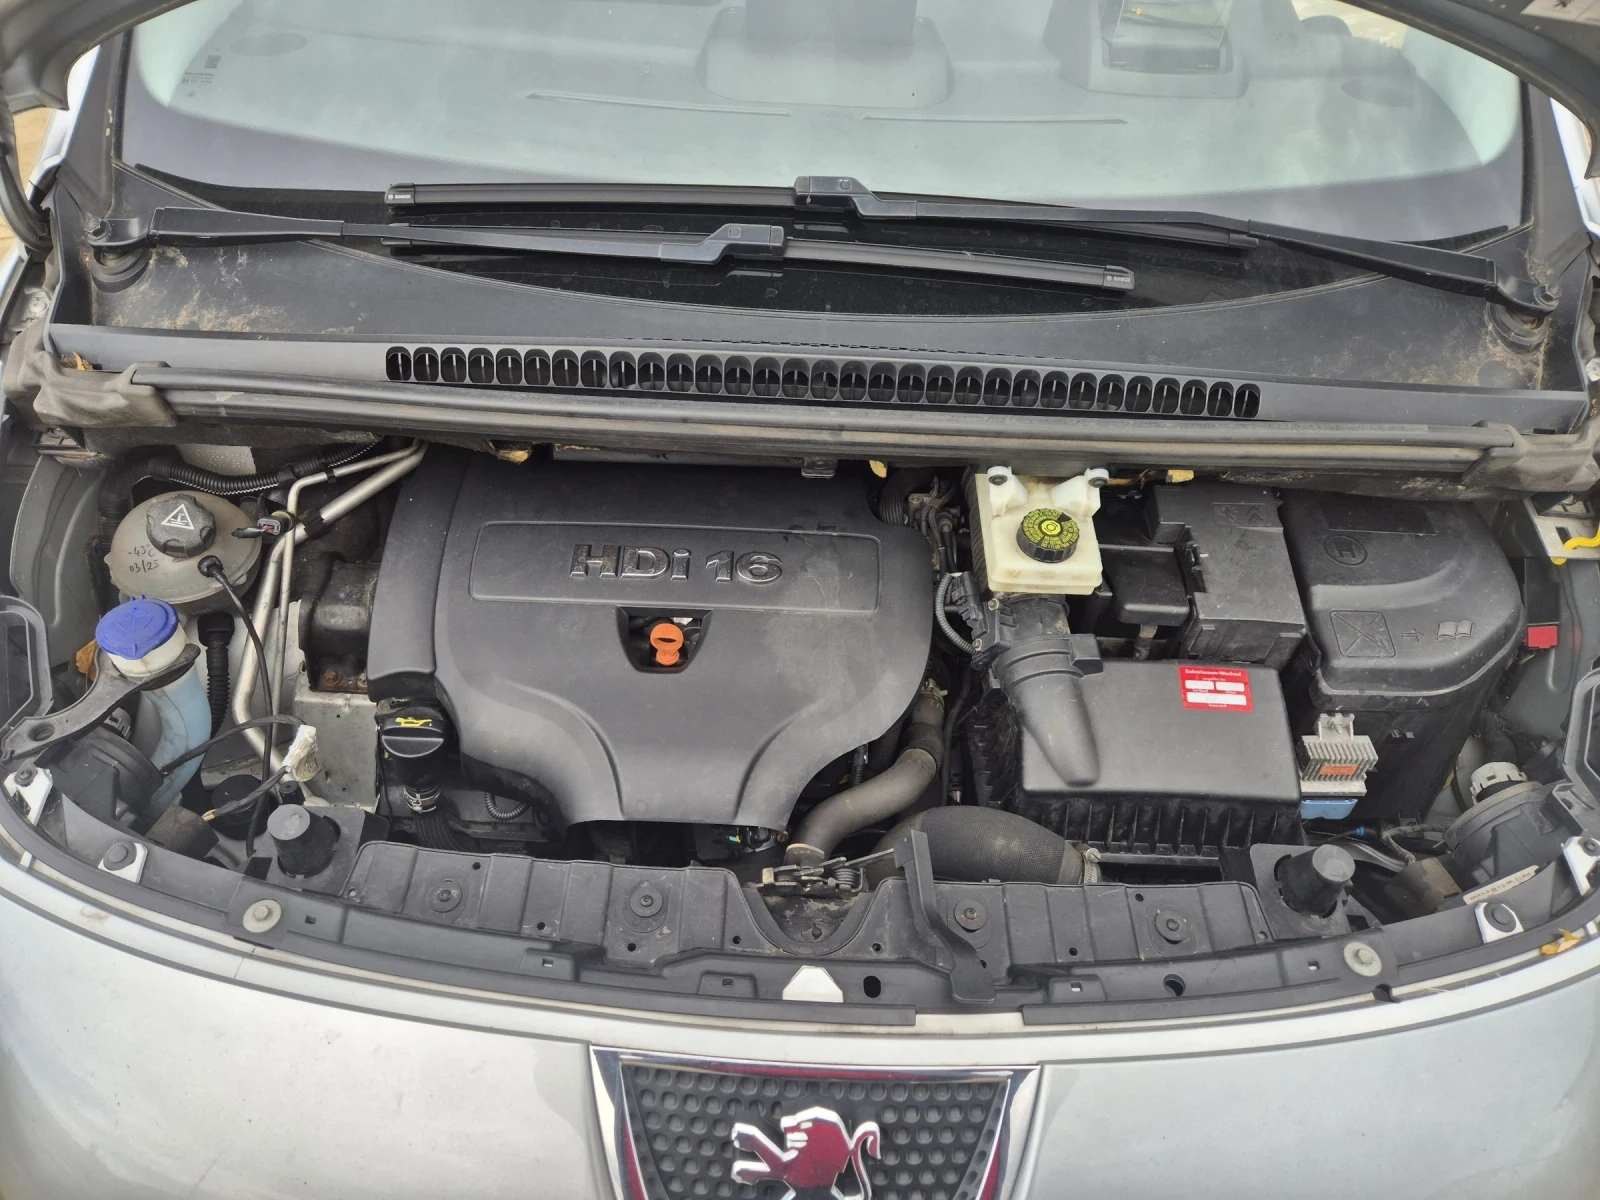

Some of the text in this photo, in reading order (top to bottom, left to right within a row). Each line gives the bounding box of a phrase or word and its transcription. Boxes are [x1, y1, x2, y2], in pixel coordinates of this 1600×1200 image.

[129, 559, 160, 574] 03/25
[569, 544, 783, 584] HDi 16
